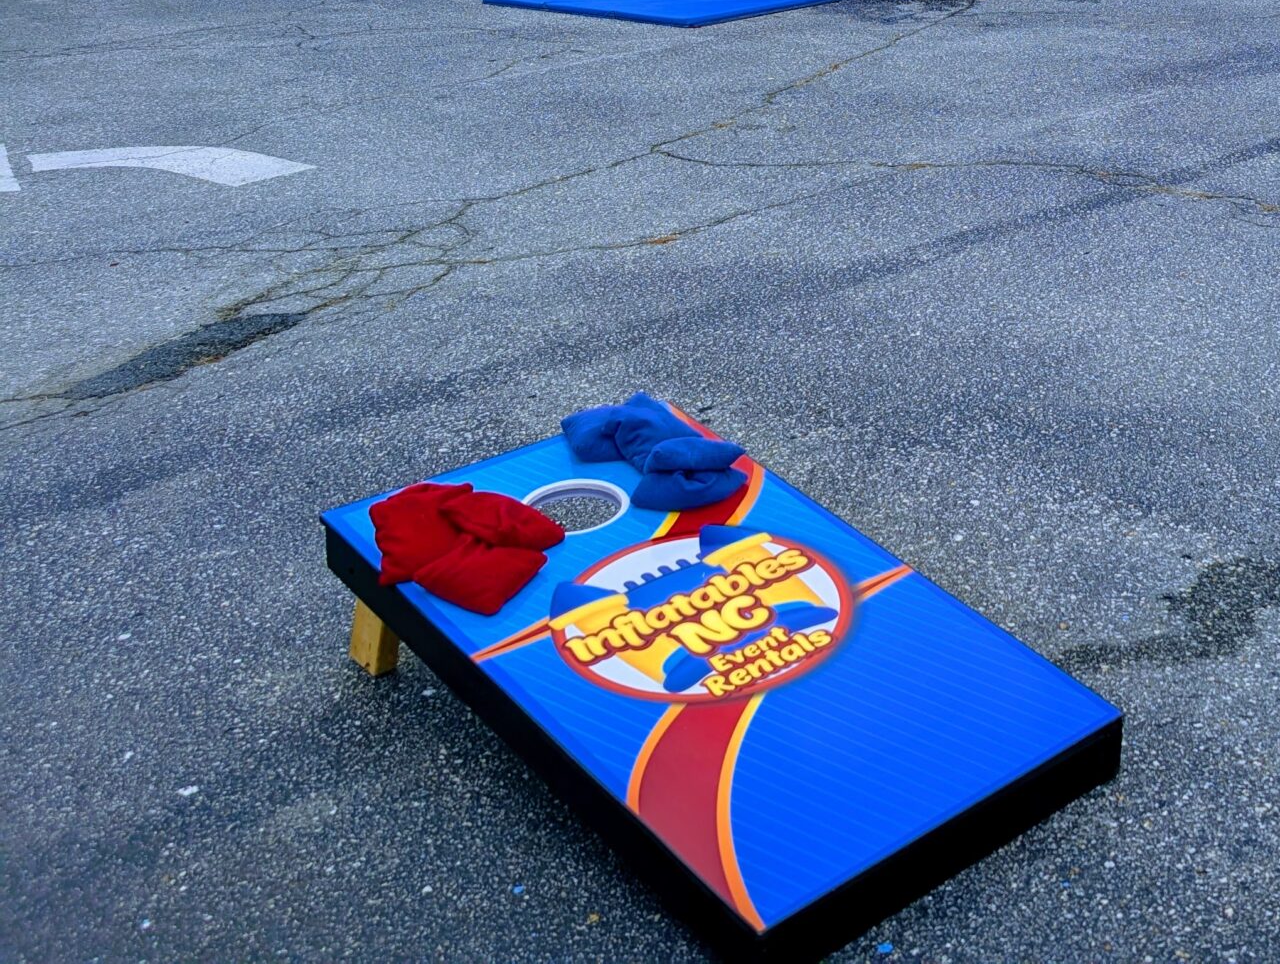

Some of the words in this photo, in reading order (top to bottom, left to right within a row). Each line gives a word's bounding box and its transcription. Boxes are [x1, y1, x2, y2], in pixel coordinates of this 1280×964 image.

[564, 548, 810, 663] Inflatables
[670, 595, 769, 654] NC
[703, 630, 832, 697] Rentals
[709, 627, 789, 672] Event
